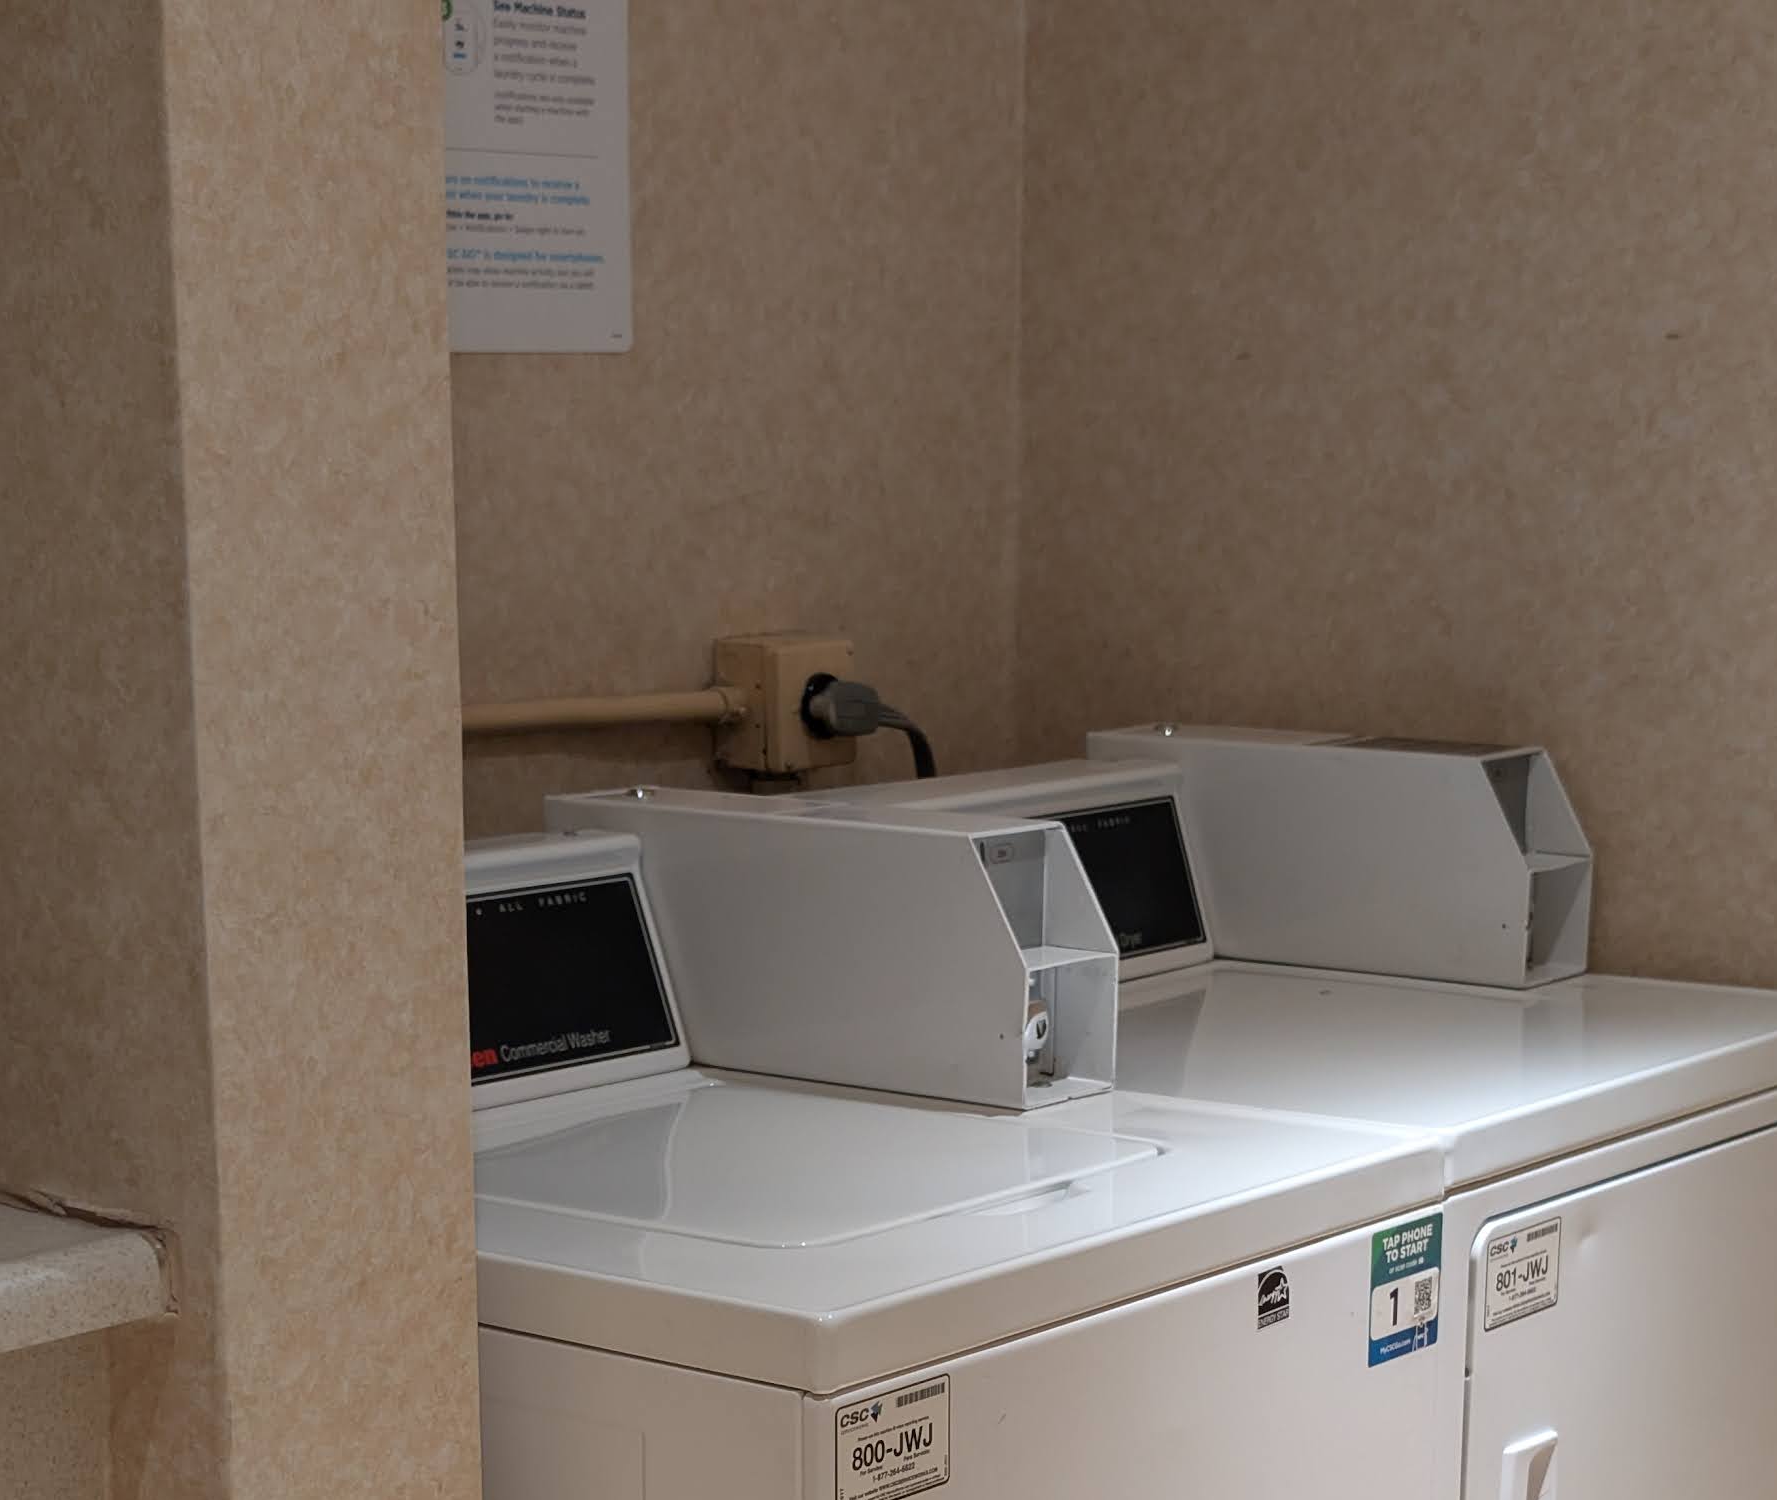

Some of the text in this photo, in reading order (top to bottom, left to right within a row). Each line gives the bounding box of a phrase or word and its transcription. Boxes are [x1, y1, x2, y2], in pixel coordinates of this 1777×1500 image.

[494, 0, 586, 18] See Machine Status
[538, 892, 587, 908] FABRIC
[500, 1034, 568, 1062] Commercial
[567, 1028, 612, 1050] Washer
[1382, 1223, 1434, 1251] TAP PHONE
[1490, 1241, 1510, 1257] CSC
[1385, 1238, 1430, 1264] TO START
[1496, 1255, 1548, 1292] 801-JWJ
[1390, 1287, 1398, 1327] 1
[840, 1408, 870, 1428] CSC
[852, 1422, 933, 1471] 800-JWJ
